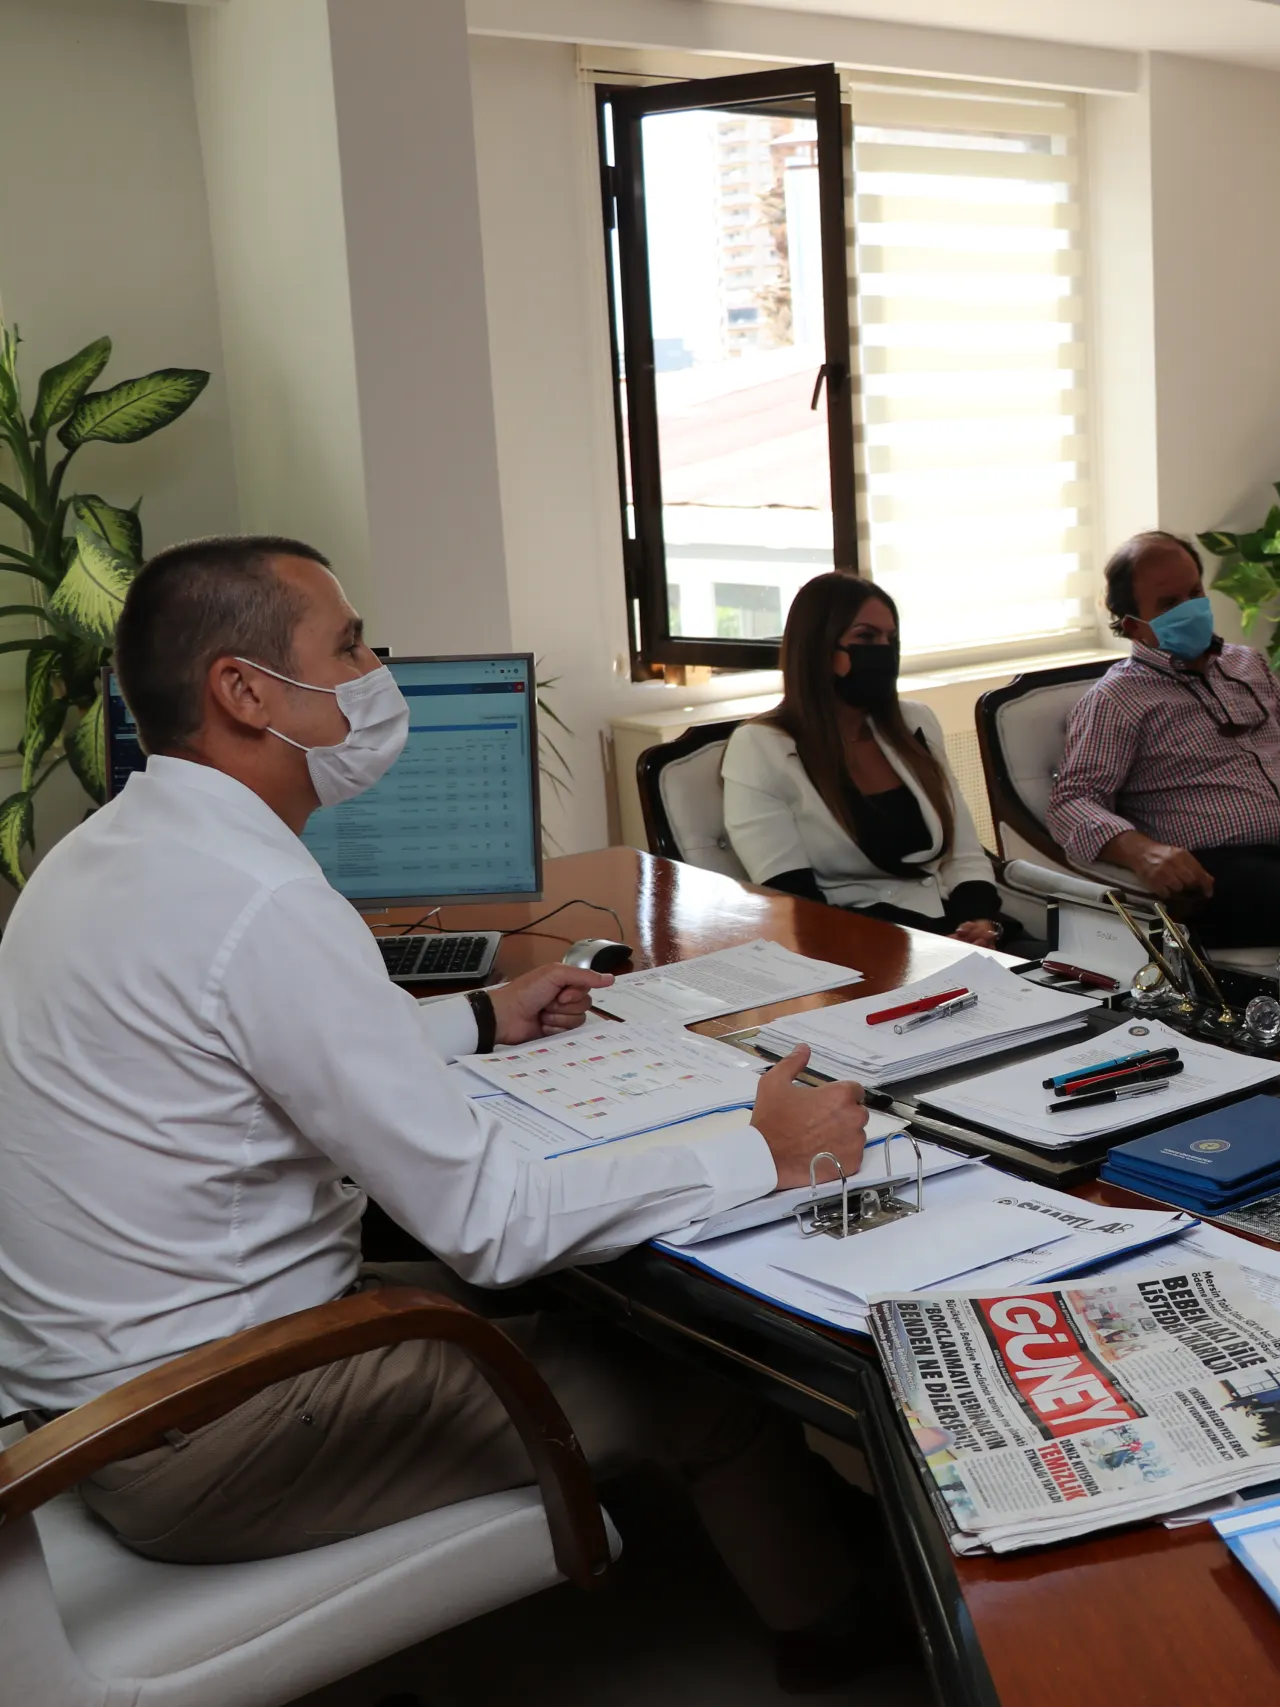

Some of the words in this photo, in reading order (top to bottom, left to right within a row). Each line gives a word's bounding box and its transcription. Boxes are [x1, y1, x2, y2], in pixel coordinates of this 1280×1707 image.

[1137, 1280, 1193, 1335] LİSTEDEN
[1192, 1272, 1207, 1298] ödeme
[1202, 1271, 1220, 1298] Mersin
[897, 1302, 935, 1355] BENDEN
[917, 1359, 944, 1380] NE
[960, 1331, 976, 1361] Belediye
[1162, 1275, 1213, 1324] BEBEK
[1221, 1342, 1268, 1369] BİLE
[989, 1298, 1131, 1426] GÜNEY
[1037, 1443, 1088, 1501] TEMİZLİK
[1041, 1479, 1063, 1503] YAPILDI
[1059, 1439, 1080, 1460] DENİZ
[1071, 1461, 1102, 1497] KIYISINDA
